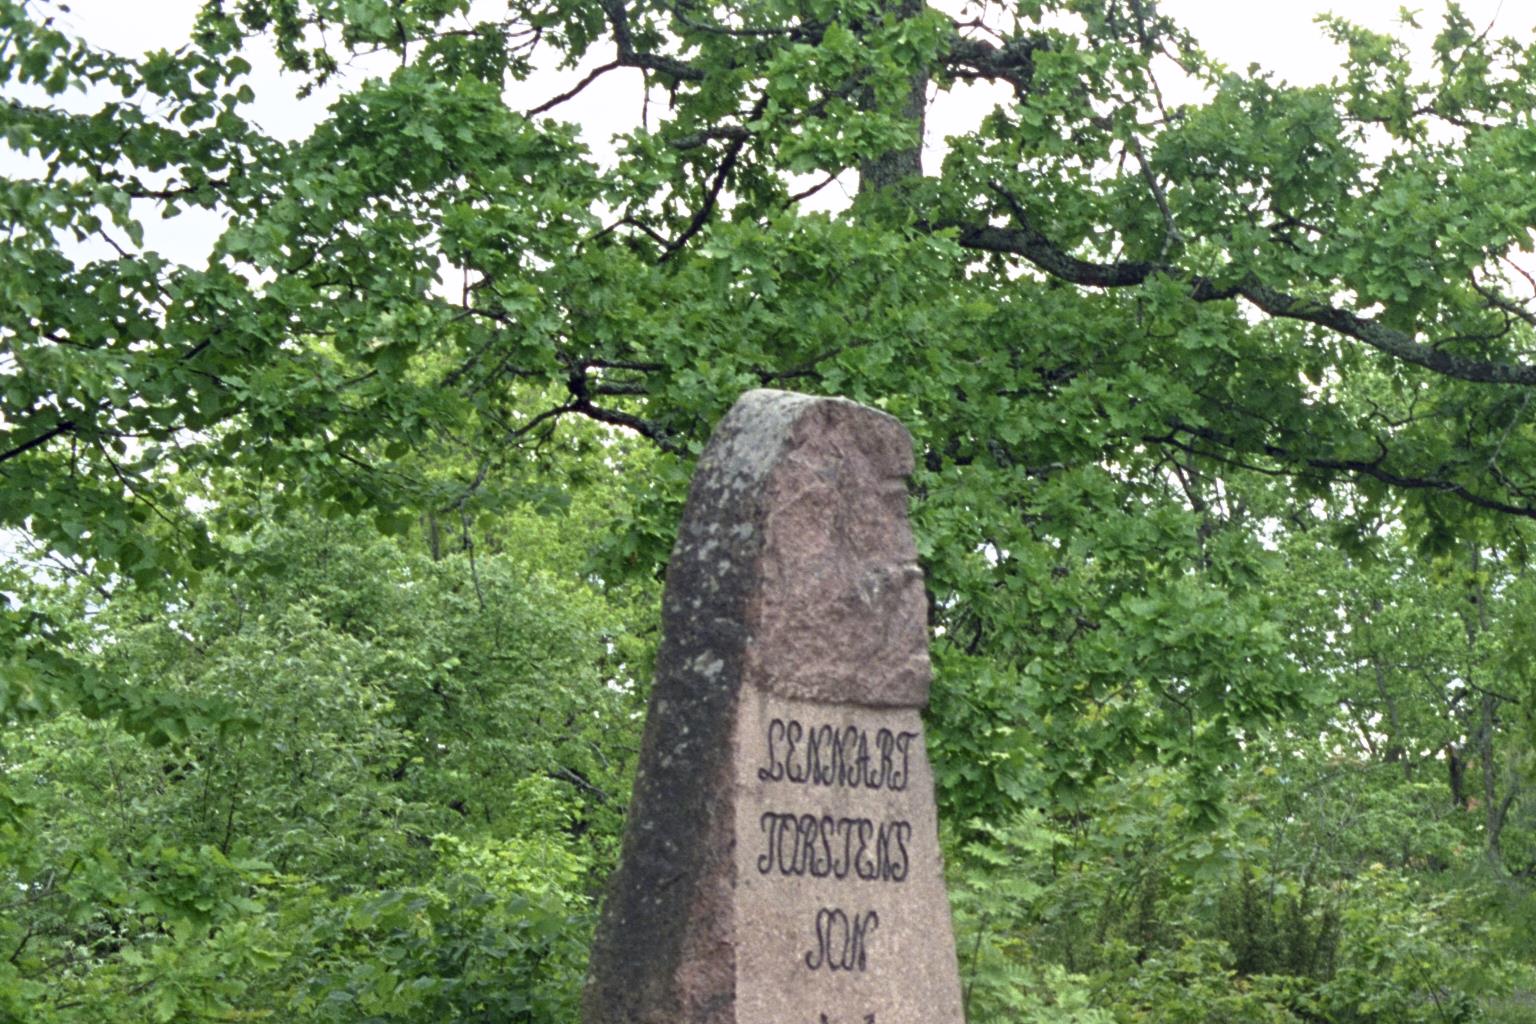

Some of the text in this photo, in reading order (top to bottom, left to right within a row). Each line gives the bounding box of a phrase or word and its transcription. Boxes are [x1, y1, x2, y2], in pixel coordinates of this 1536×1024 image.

[757, 718, 919, 791] LENNART
[757, 811, 912, 882] TORSTENS
[805, 907, 879, 972] SON
